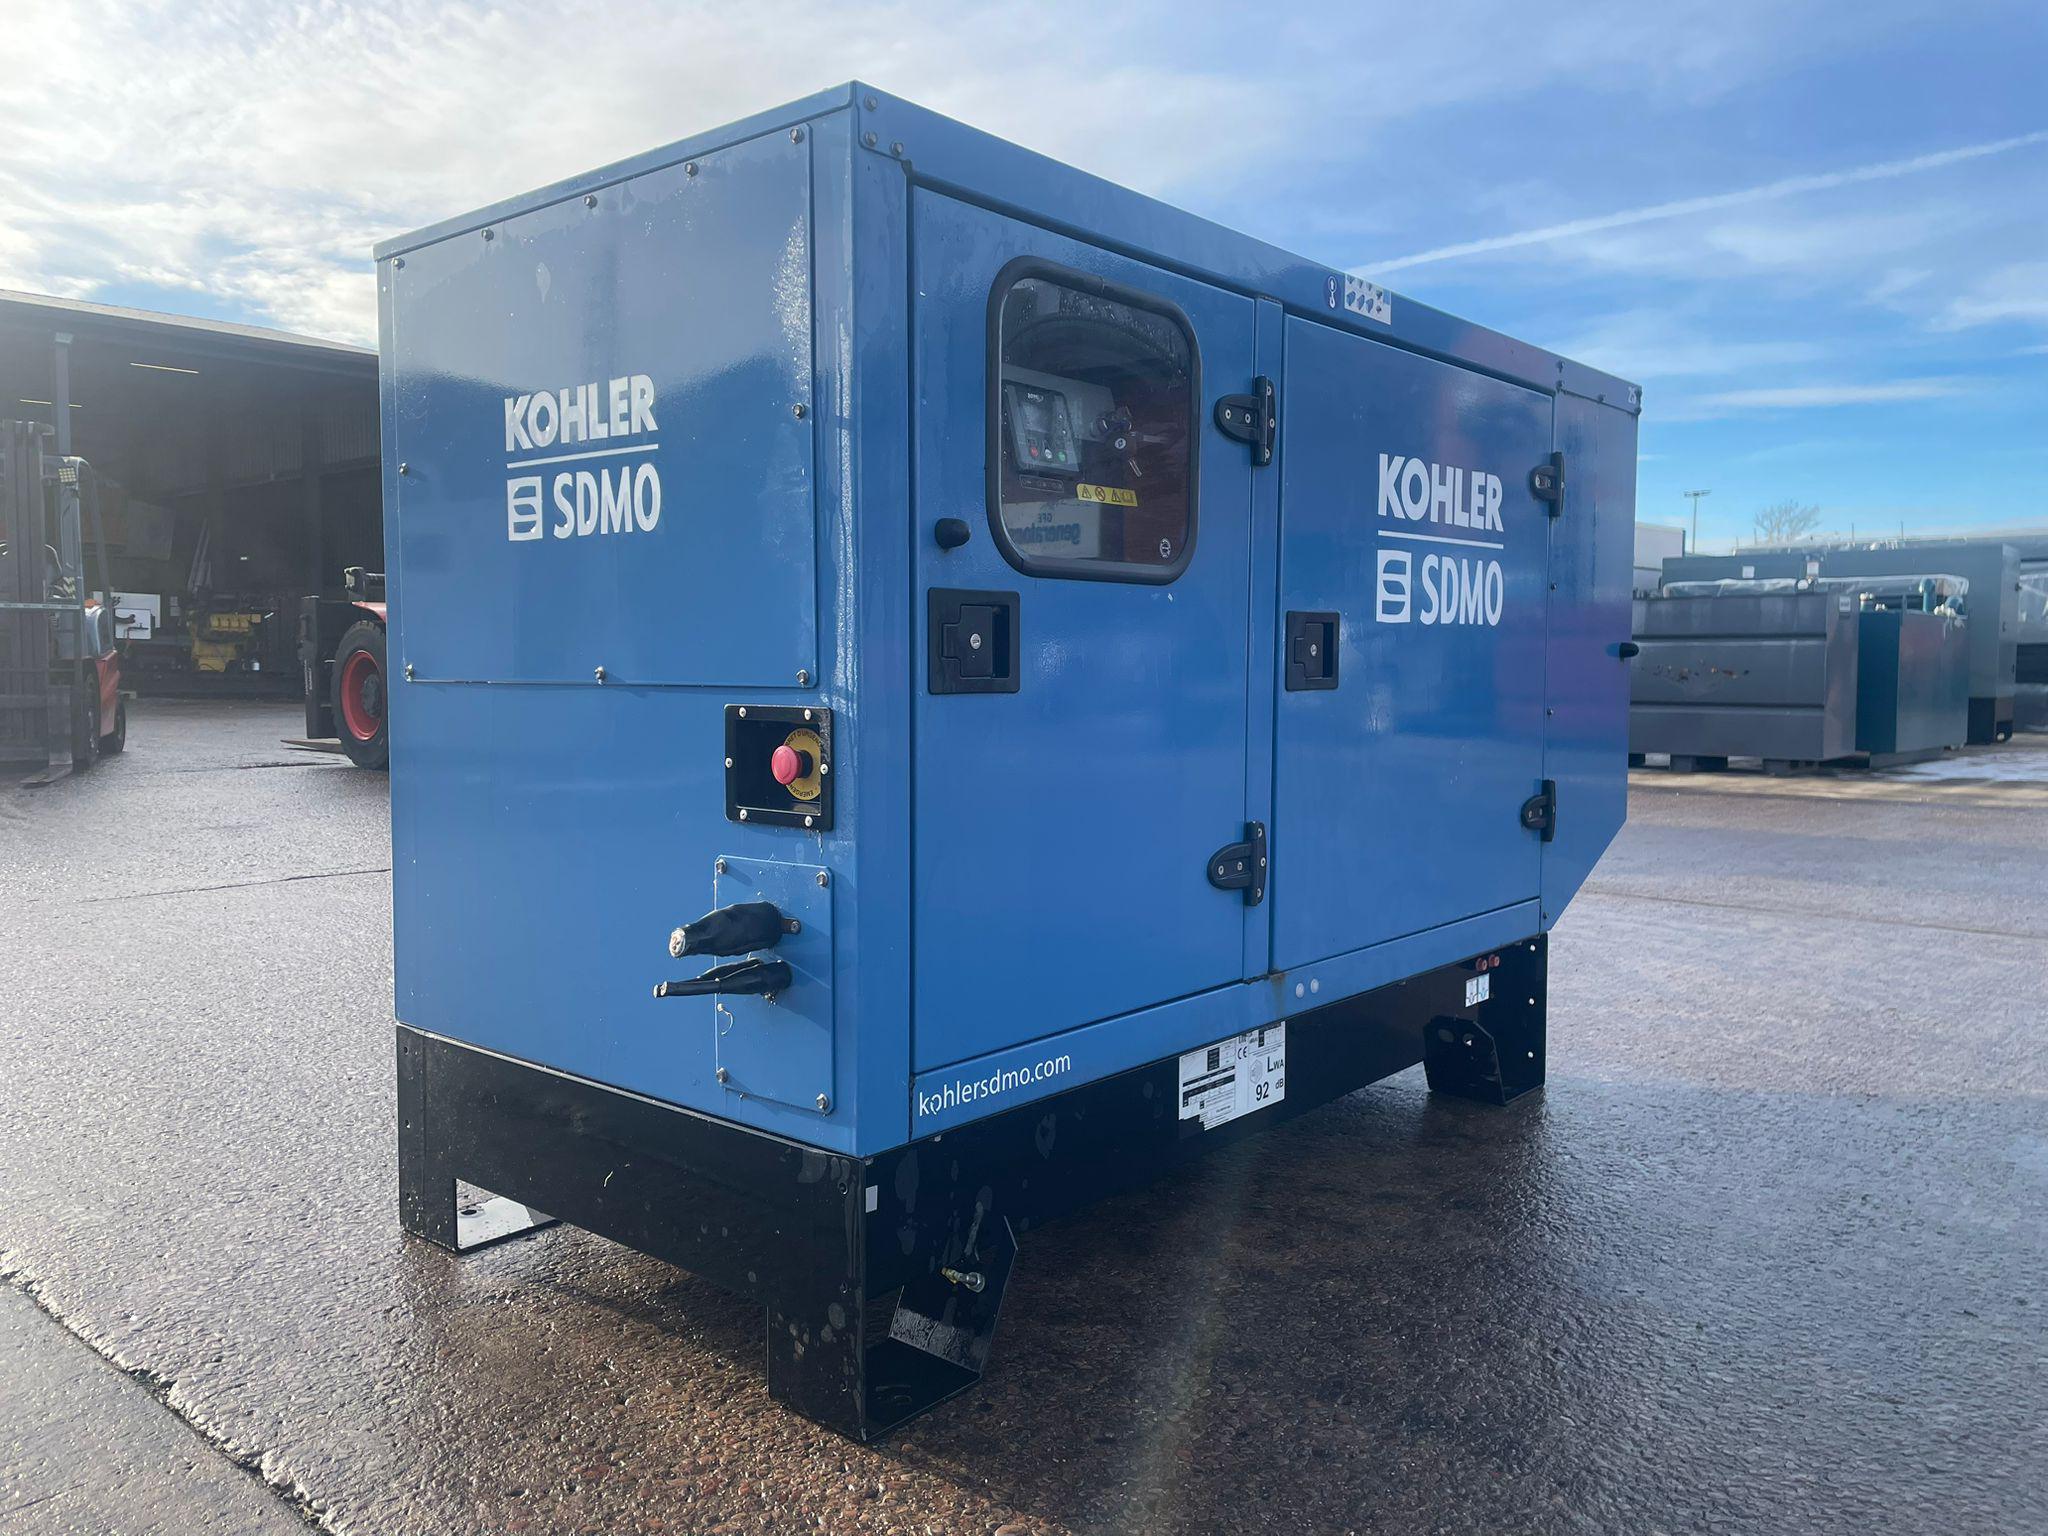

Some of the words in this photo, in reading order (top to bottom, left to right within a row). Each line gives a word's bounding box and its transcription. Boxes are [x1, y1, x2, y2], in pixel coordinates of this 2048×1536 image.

[504, 374, 659, 452] KOHLER
[553, 463, 661, 539] SDMO
[1377, 453, 1504, 532] KOHLER
[1420, 554, 1504, 626] SDMO
[919, 1054, 1071, 1117] kohlersdmo.com
[1255, 1081, 1269, 1102] 92
